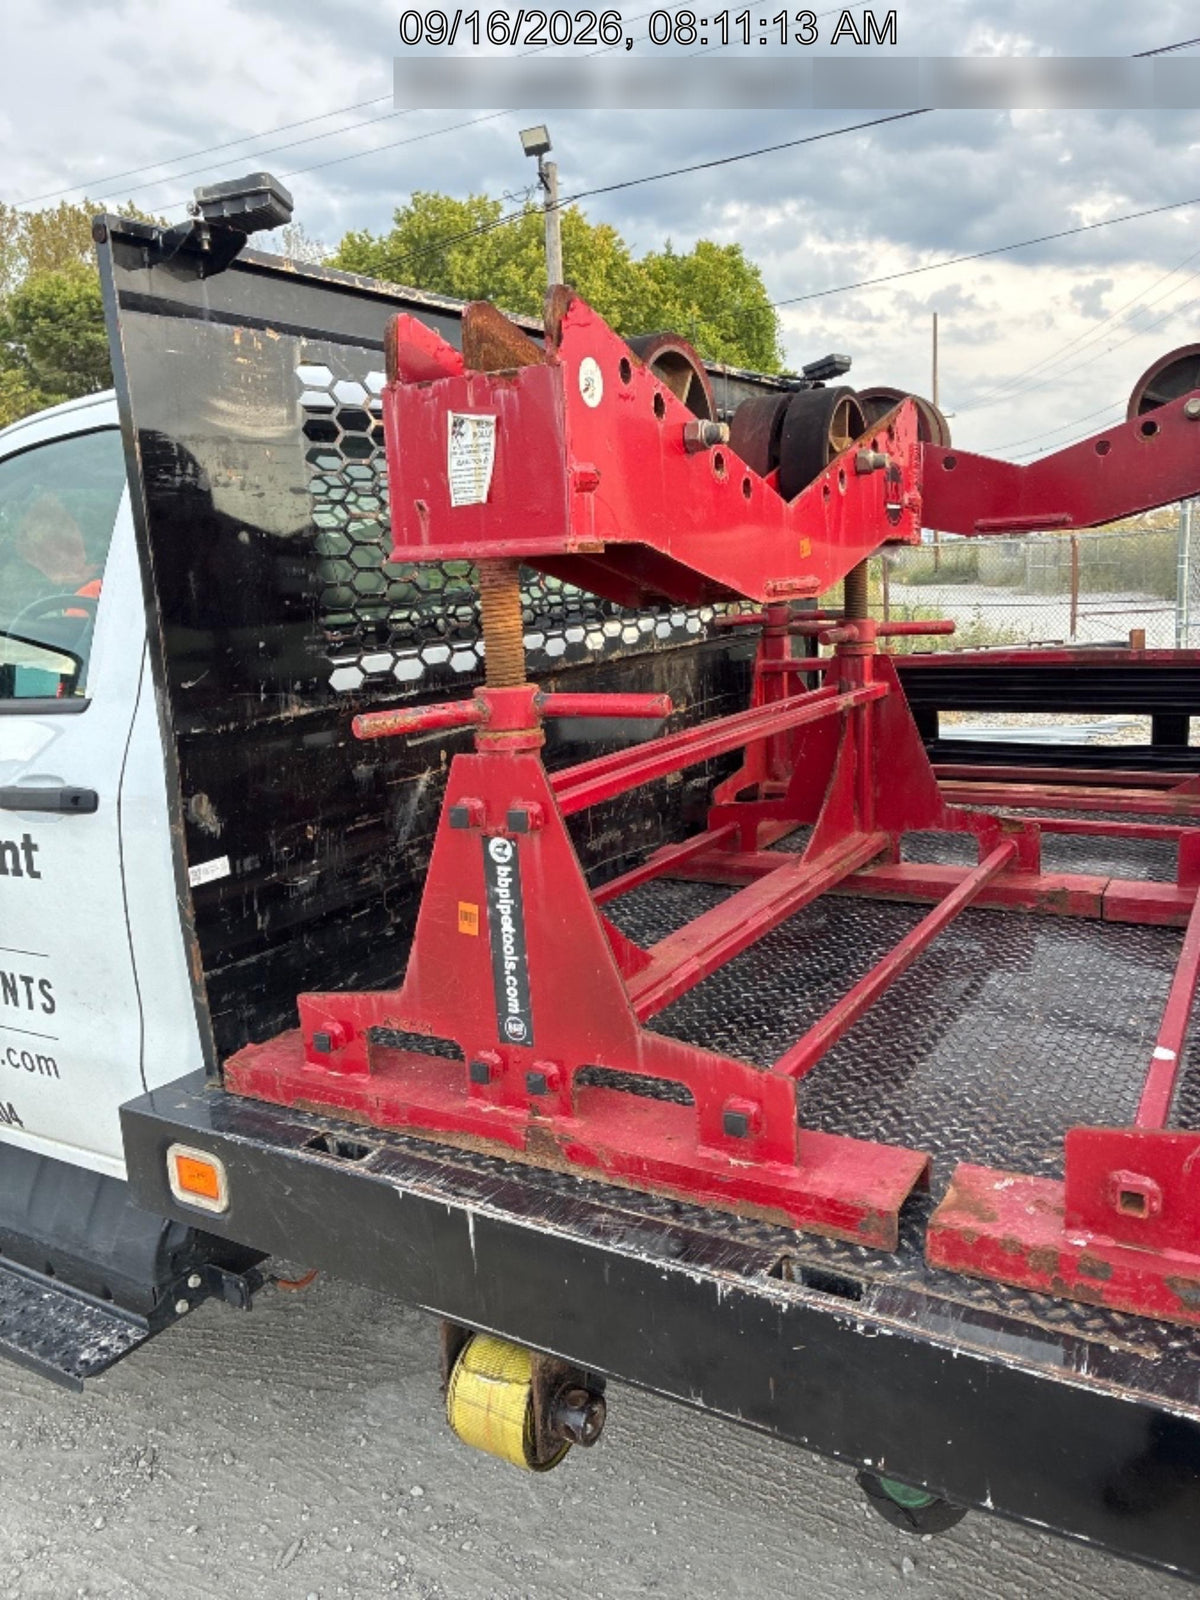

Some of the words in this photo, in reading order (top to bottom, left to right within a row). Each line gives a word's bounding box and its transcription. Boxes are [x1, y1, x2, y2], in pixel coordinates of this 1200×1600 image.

[496, 864, 521, 1014] bbpipetools.com
[0, 970, 56, 1015] NTS
[1, 1047, 61, 1080] .com
